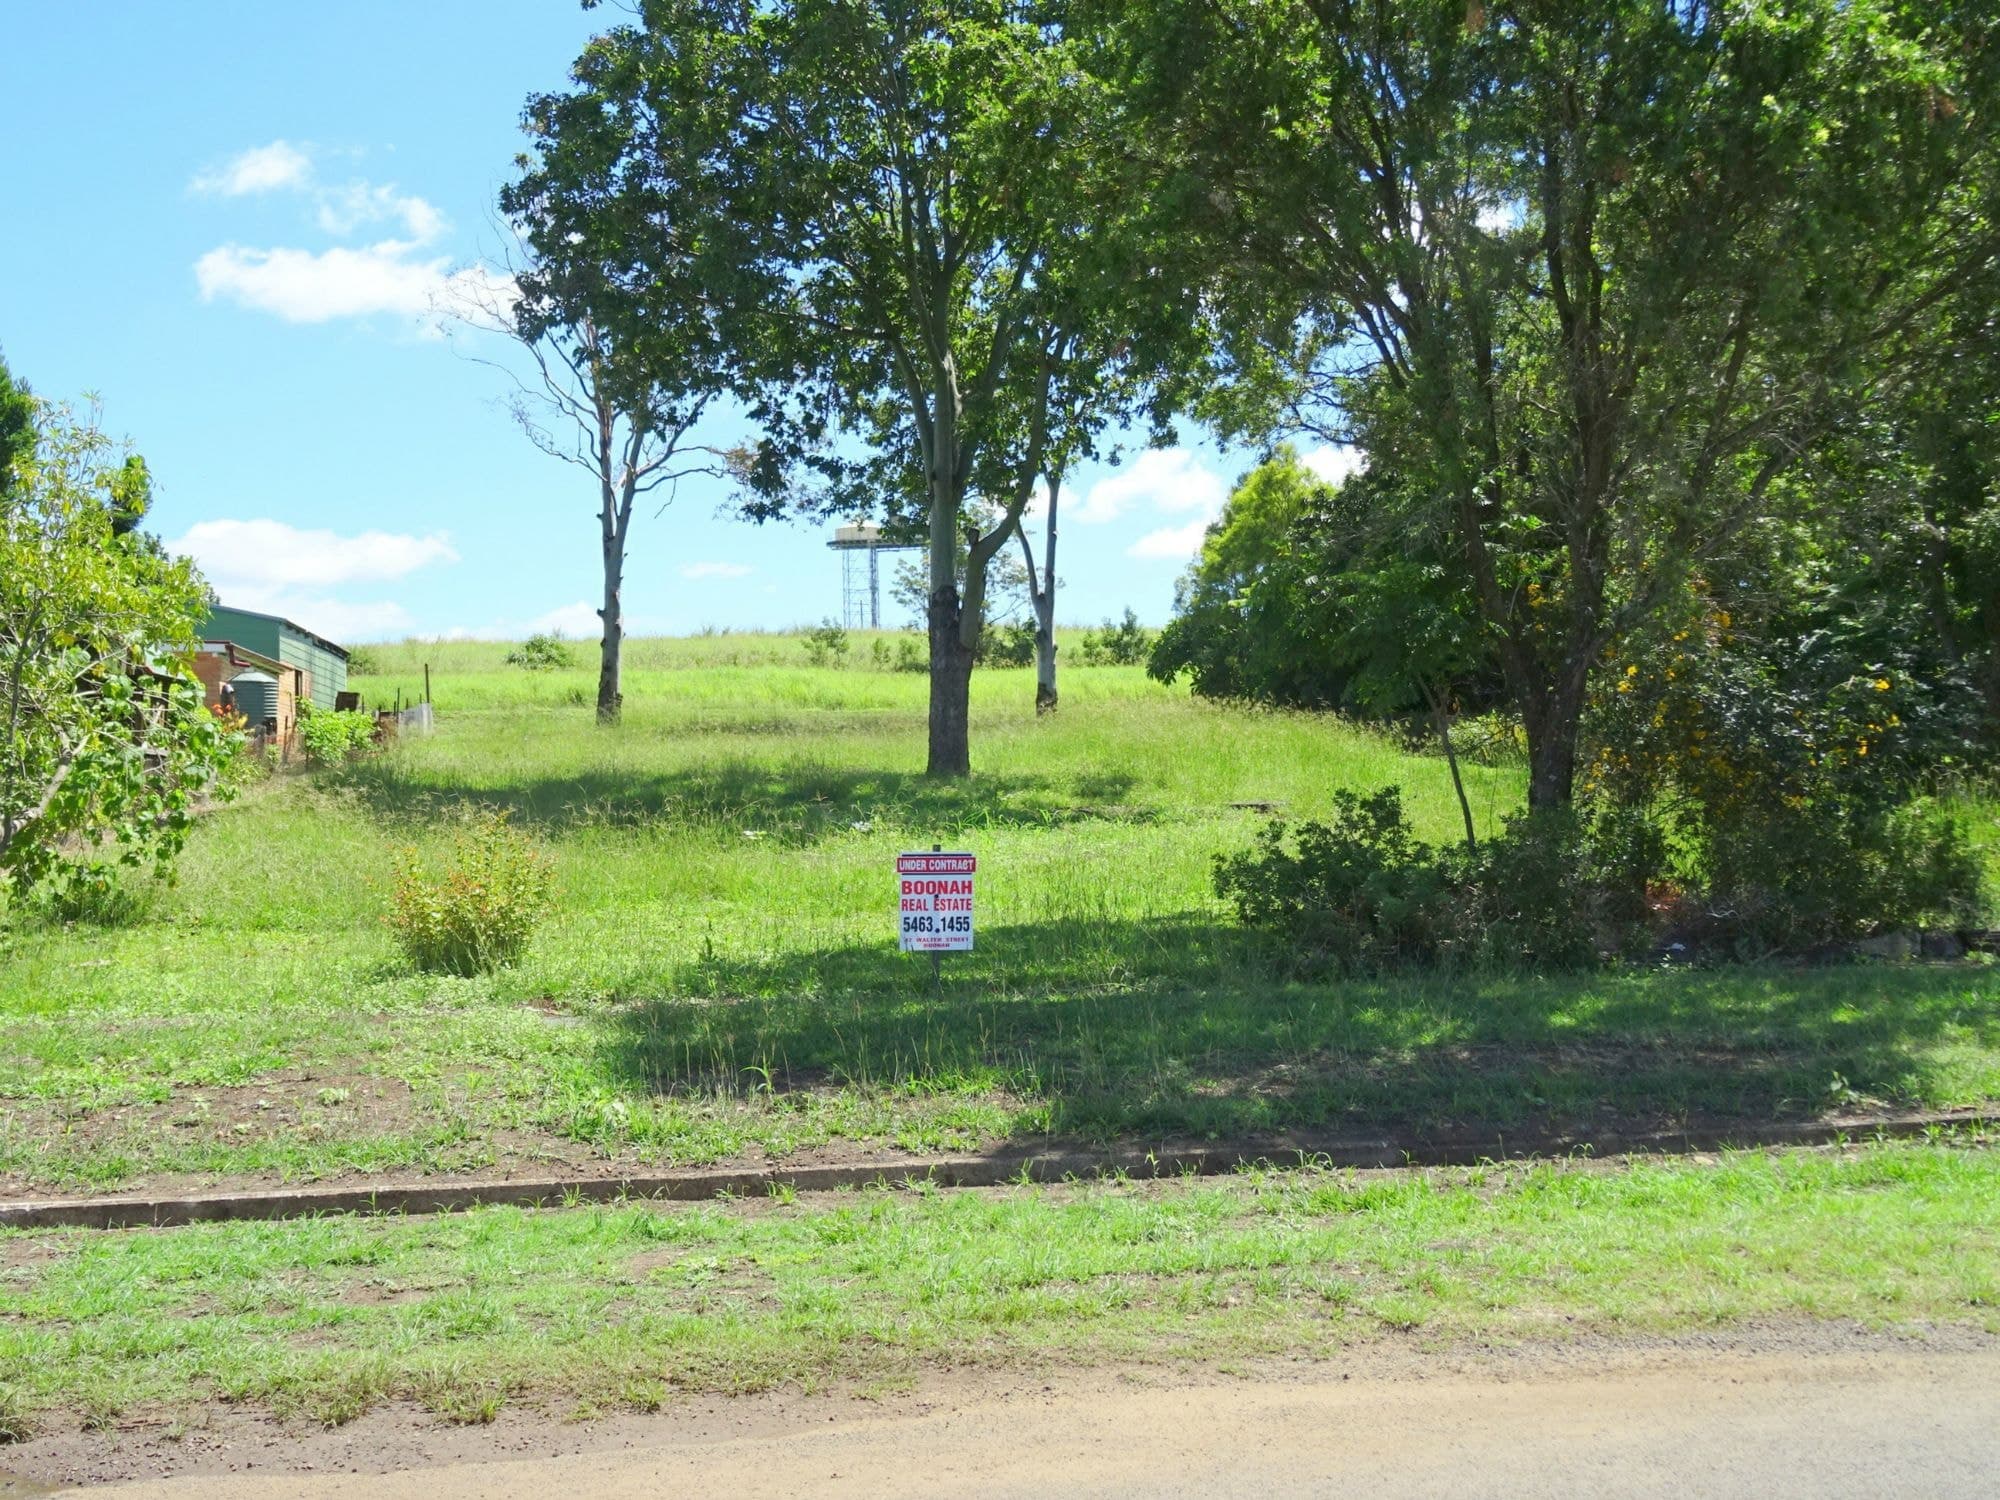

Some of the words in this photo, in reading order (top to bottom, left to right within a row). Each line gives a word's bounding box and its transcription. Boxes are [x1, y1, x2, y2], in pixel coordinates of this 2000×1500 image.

[899, 859, 927, 870] UNDER
[929, 859, 974, 870] CONTRACT
[901, 880, 972, 895] BOONAH
[901, 899, 929, 911] REAL
[933, 898, 972, 911] ESTATE
